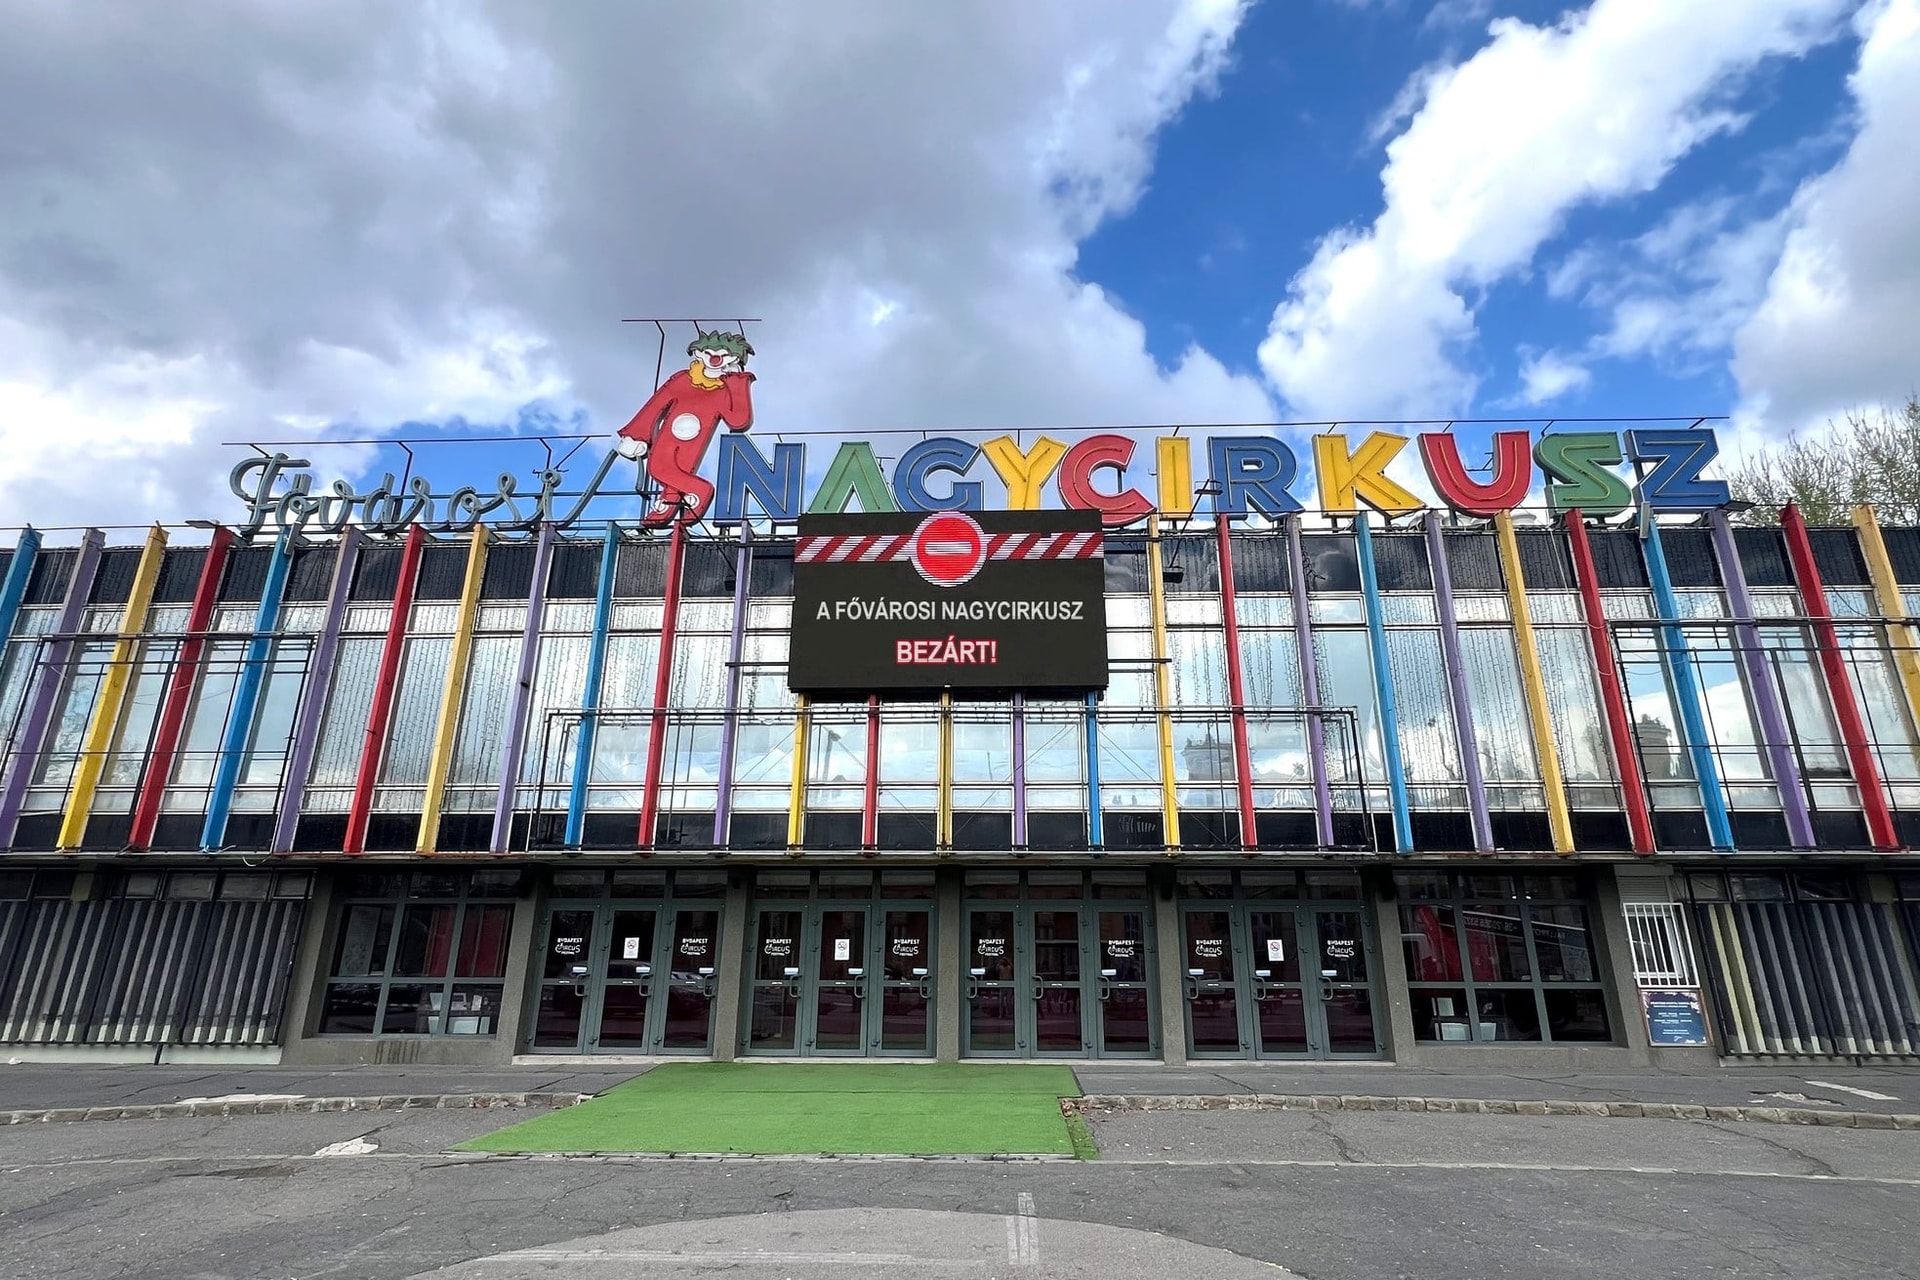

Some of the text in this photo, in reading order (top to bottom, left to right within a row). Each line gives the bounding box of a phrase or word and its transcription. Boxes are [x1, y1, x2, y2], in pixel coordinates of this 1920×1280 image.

[714, 428, 1731, 527] NAGYCIRKUSZ
[816, 597, 1083, 620] A FŐVÁROSI NAGYCIRKUSZ
[896, 636, 997, 663] BEZÁRT!
